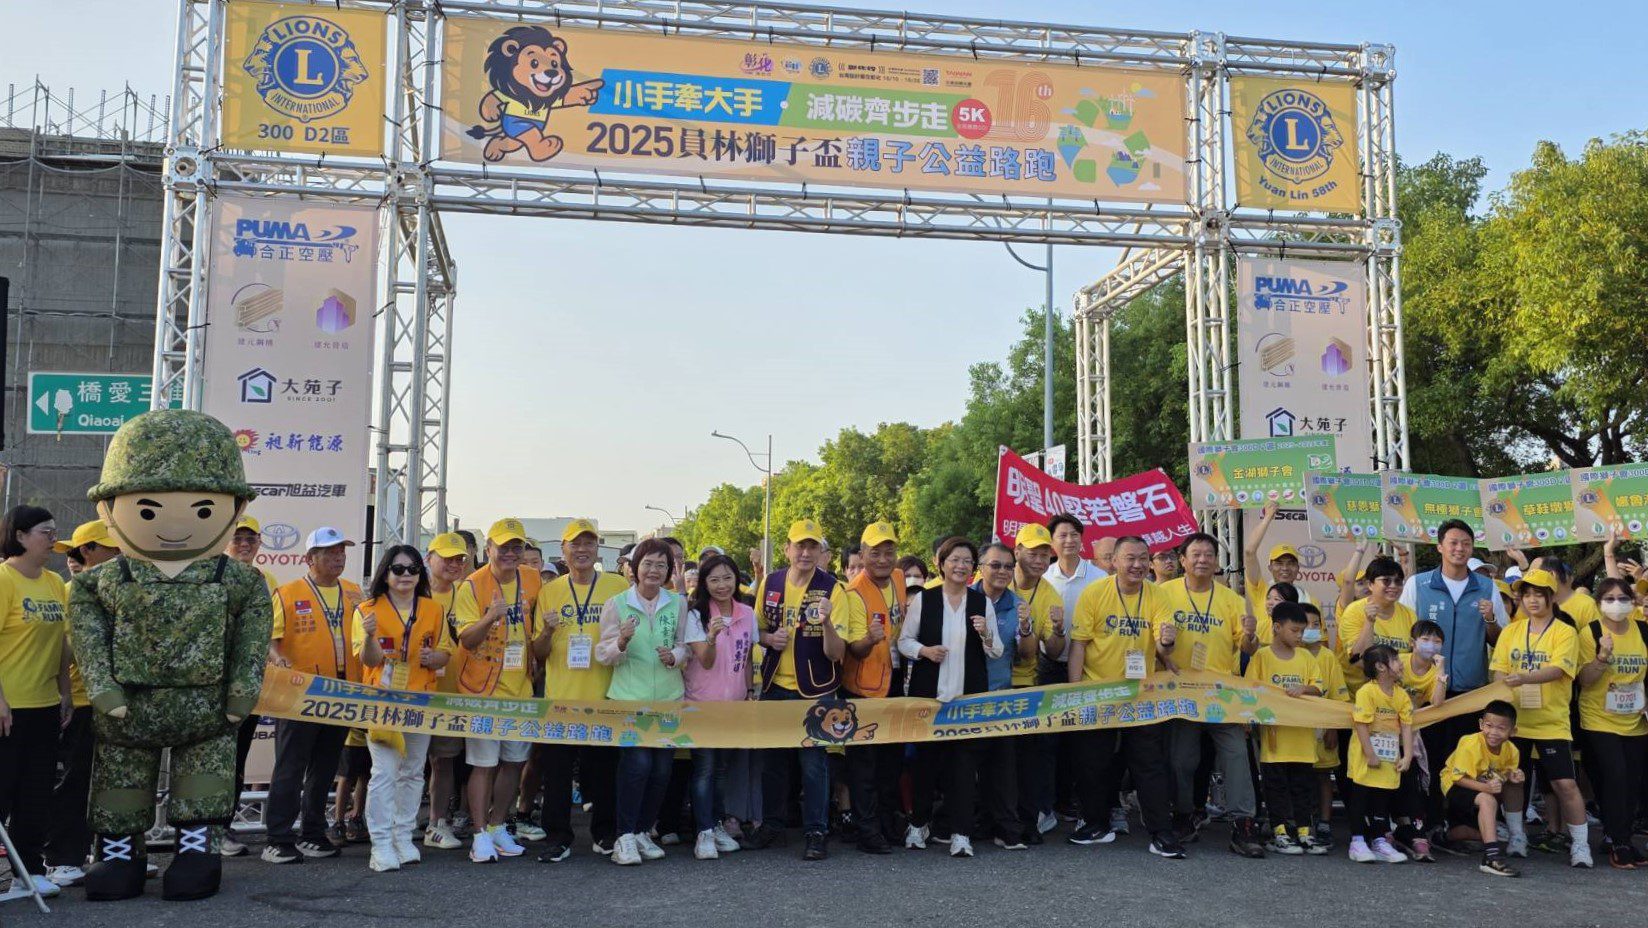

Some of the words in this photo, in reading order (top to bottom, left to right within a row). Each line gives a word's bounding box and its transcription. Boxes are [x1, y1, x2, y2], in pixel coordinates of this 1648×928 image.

[271, 20, 343, 44] LIONS
[293, 49, 324, 86] L
[270, 92, 340, 114] INTERNATIONAL
[613, 80, 763, 118] 小手牽大手
[806, 92, 949, 132] 減碳齊步走
[1265, 93, 1320, 114] LIONS
[959, 106, 985, 122] 5K
[258, 123, 294, 140] 300
[304, 126, 350, 145] D2區
[1285, 118, 1310, 150] L
[1269, 158, 1324, 176] INTERNATIONAL
[1259, 176, 1286, 198] Yuan
[1290, 190, 1309, 200] Lin
[236, 219, 311, 241] PUMA
[260, 246, 333, 263] 合正空壓
[1256, 276, 1312, 295] PUMA
[1275, 299, 1331, 315] 合正空壓
[281, 378, 343, 396] 大苑子
[1300, 417, 1347, 433] 大苑子
[285, 483, 346, 498] 旭益汽車
[256, 553, 313, 565] OYOTA
[1296, 571, 1336, 582] OYOTA
[1187, 614, 1224, 627] FAMILY
[1187, 623, 1210, 633] RUN
[1617, 665, 1639, 673] RUN
